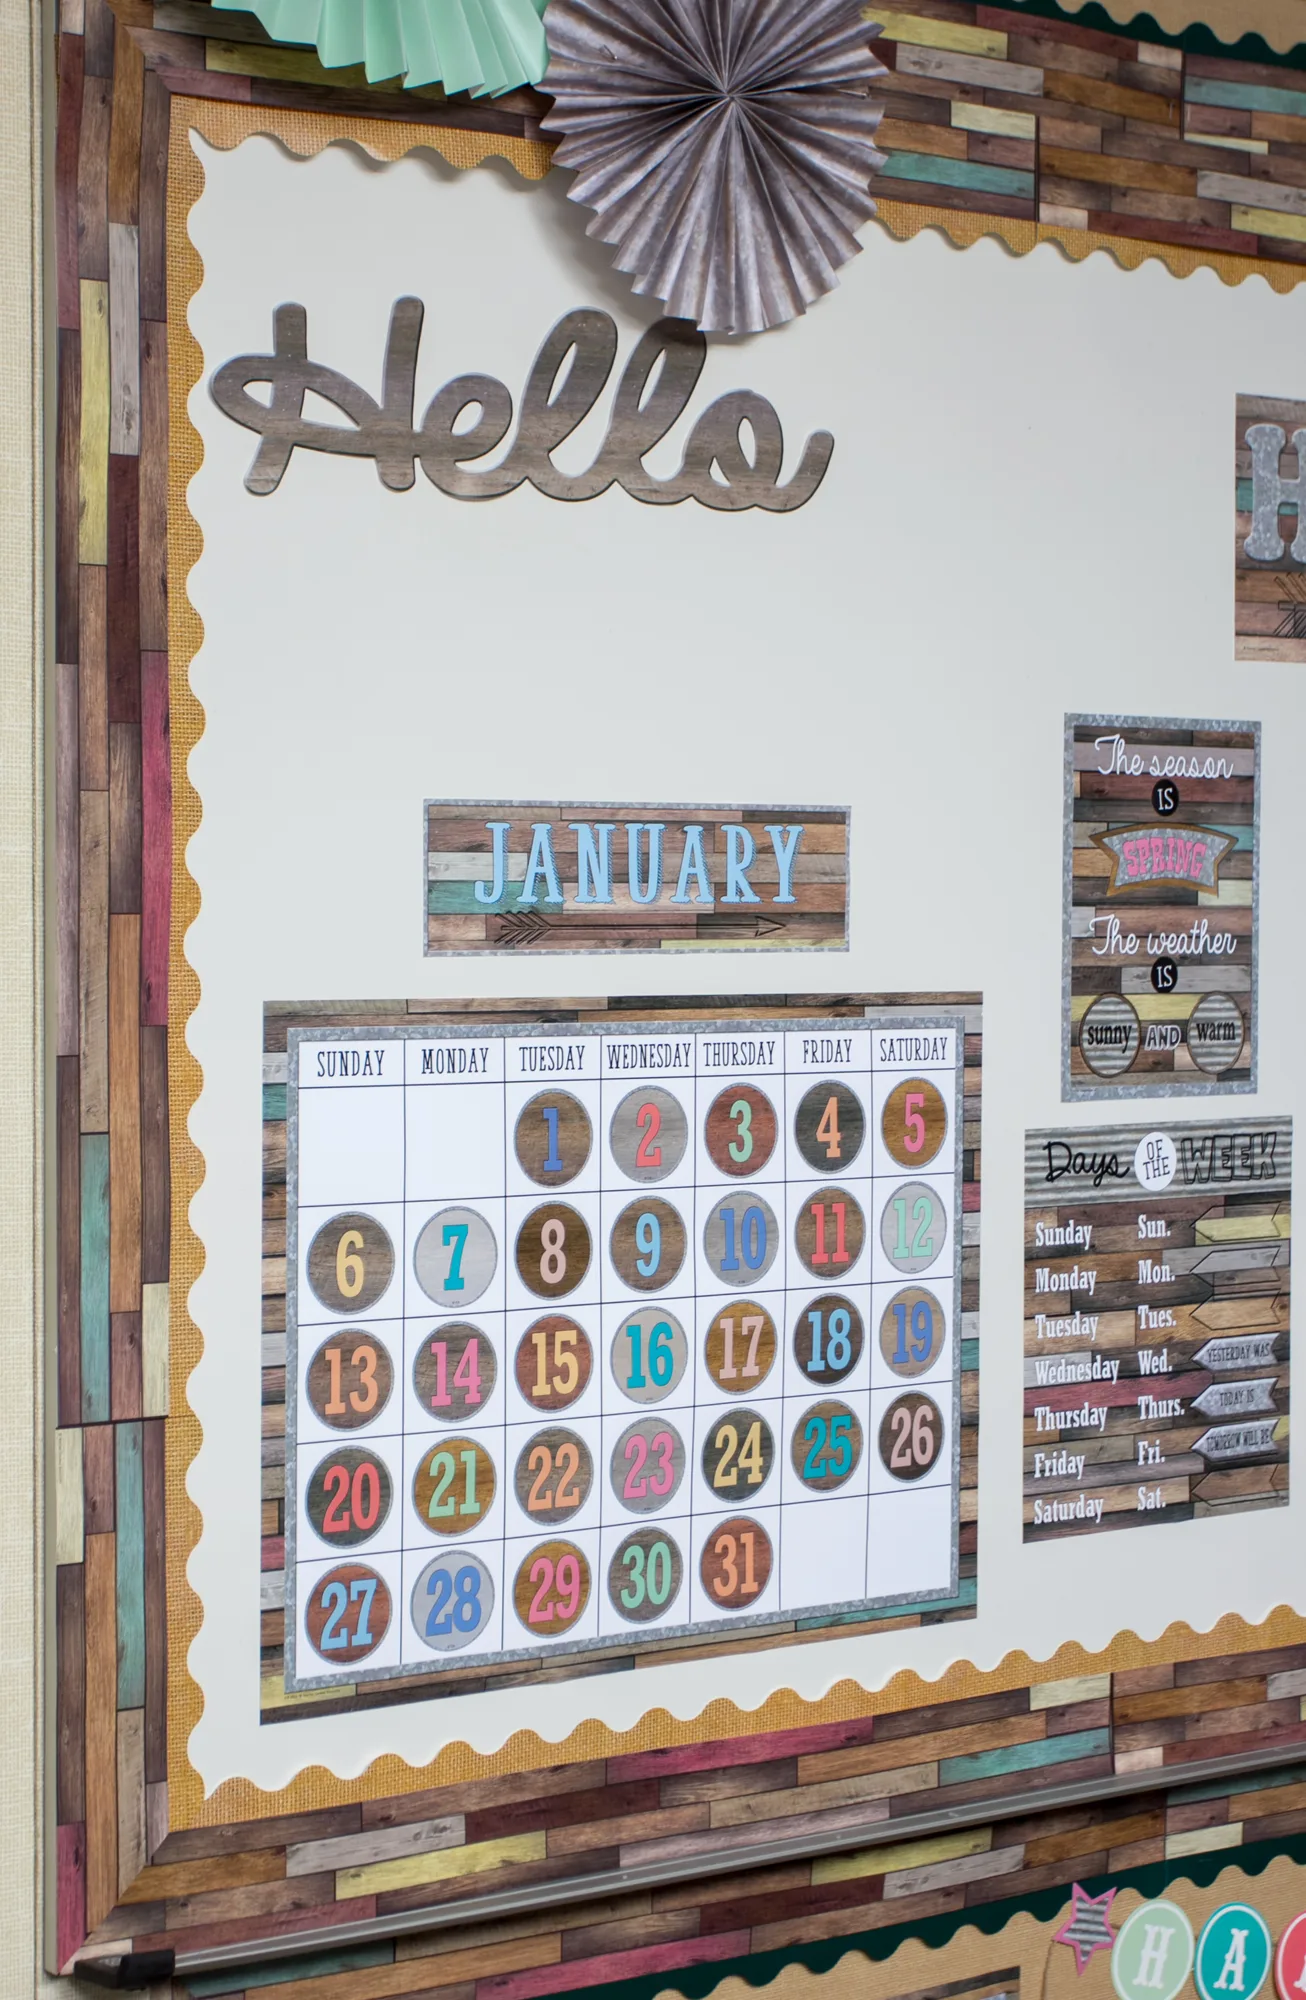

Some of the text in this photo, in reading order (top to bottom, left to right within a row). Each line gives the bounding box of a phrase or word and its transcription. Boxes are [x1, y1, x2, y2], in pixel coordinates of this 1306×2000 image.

[208, 295, 834, 513] Hello
[1094, 734, 1233, 779] The season
[1158, 787, 1173, 811] IS
[474, 822, 804, 904] JANUARY
[1122, 837, 1207, 878] SPRING
[1089, 914, 1236, 955] The weather
[1158, 965, 1172, 988] IS
[317, 1037, 948, 1077] SUNDAY MONDAY TUESDAY WEDNESDAY THURSDAY FRIDAY SATURDAY
[1087, 1021, 1132, 1054] sunny
[1145, 1025, 1181, 1051] AND
[1196, 1019, 1235, 1042] warm
[544, 1107, 562, 1171] 1
[635, 1103, 662, 1167] 2
[728, 1100, 753, 1162] 3
[815, 1097, 841, 1158] 4
[903, 1093, 926, 1152] 5
[1146, 1139, 1163, 1161] OF
[1043, 1141, 1130, 1187] Days
[1143, 1158, 1170, 1179] THE
[1181, 1132, 1277, 1185] WEEK
[539, 1218, 566, 1284] 8
[635, 1212, 661, 1277] 9
[719, 1206, 767, 1271] 10
[810, 1202, 849, 1265] 11
[892, 1197, 933, 1258] 12
[1035, 1220, 1092, 1251] Sunday
[1138, 1214, 1171, 1239] Sun.
[335, 1230, 364, 1298] 6
[442, 1224, 469, 1291] 7
[1035, 1265, 1097, 1295] Monday
[1138, 1258, 1175, 1285] Mon.
[807, 1309, 851, 1372] 18
[892, 1300, 932, 1363] 19
[1035, 1311, 1098, 1341] Tuesday
[1138, 1304, 1177, 1330] Tues.
[430, 1338, 481, 1407] 14
[531, 1329, 579, 1397] 15
[626, 1321, 674, 1388] 16
[718, 1316, 765, 1380] 17
[1035, 1355, 1120, 1386] Wednesday
[1138, 1349, 1173, 1376] Wed.
[1254, 1343, 1270, 1357] WAS
[323, 1345, 378, 1415] 13
[1138, 1395, 1185, 1421] Thurs.
[803, 1414, 852, 1479] 25
[890, 1405, 932, 1468] 26
[1034, 1403, 1107, 1433] Thursday
[528, 1443, 579, 1511] 22
[623, 1432, 674, 1499] 23
[713, 1422, 764, 1488] 24
[1034, 1449, 1085, 1480] Friday
[1138, 1440, 1165, 1466] Fri.
[321, 1462, 380, 1533] 20
[428, 1450, 480, 1518] 21
[1034, 1494, 1103, 1525] Saturday
[1138, 1486, 1166, 1511] Sat.
[528, 1555, 581, 1623] 29
[621, 1542, 672, 1608] 30
[713, 1532, 758, 1597] 31
[320, 1578, 377, 1651] 27
[425, 1565, 480, 1637] 28
[1132, 1923, 1306, 1994] HA
